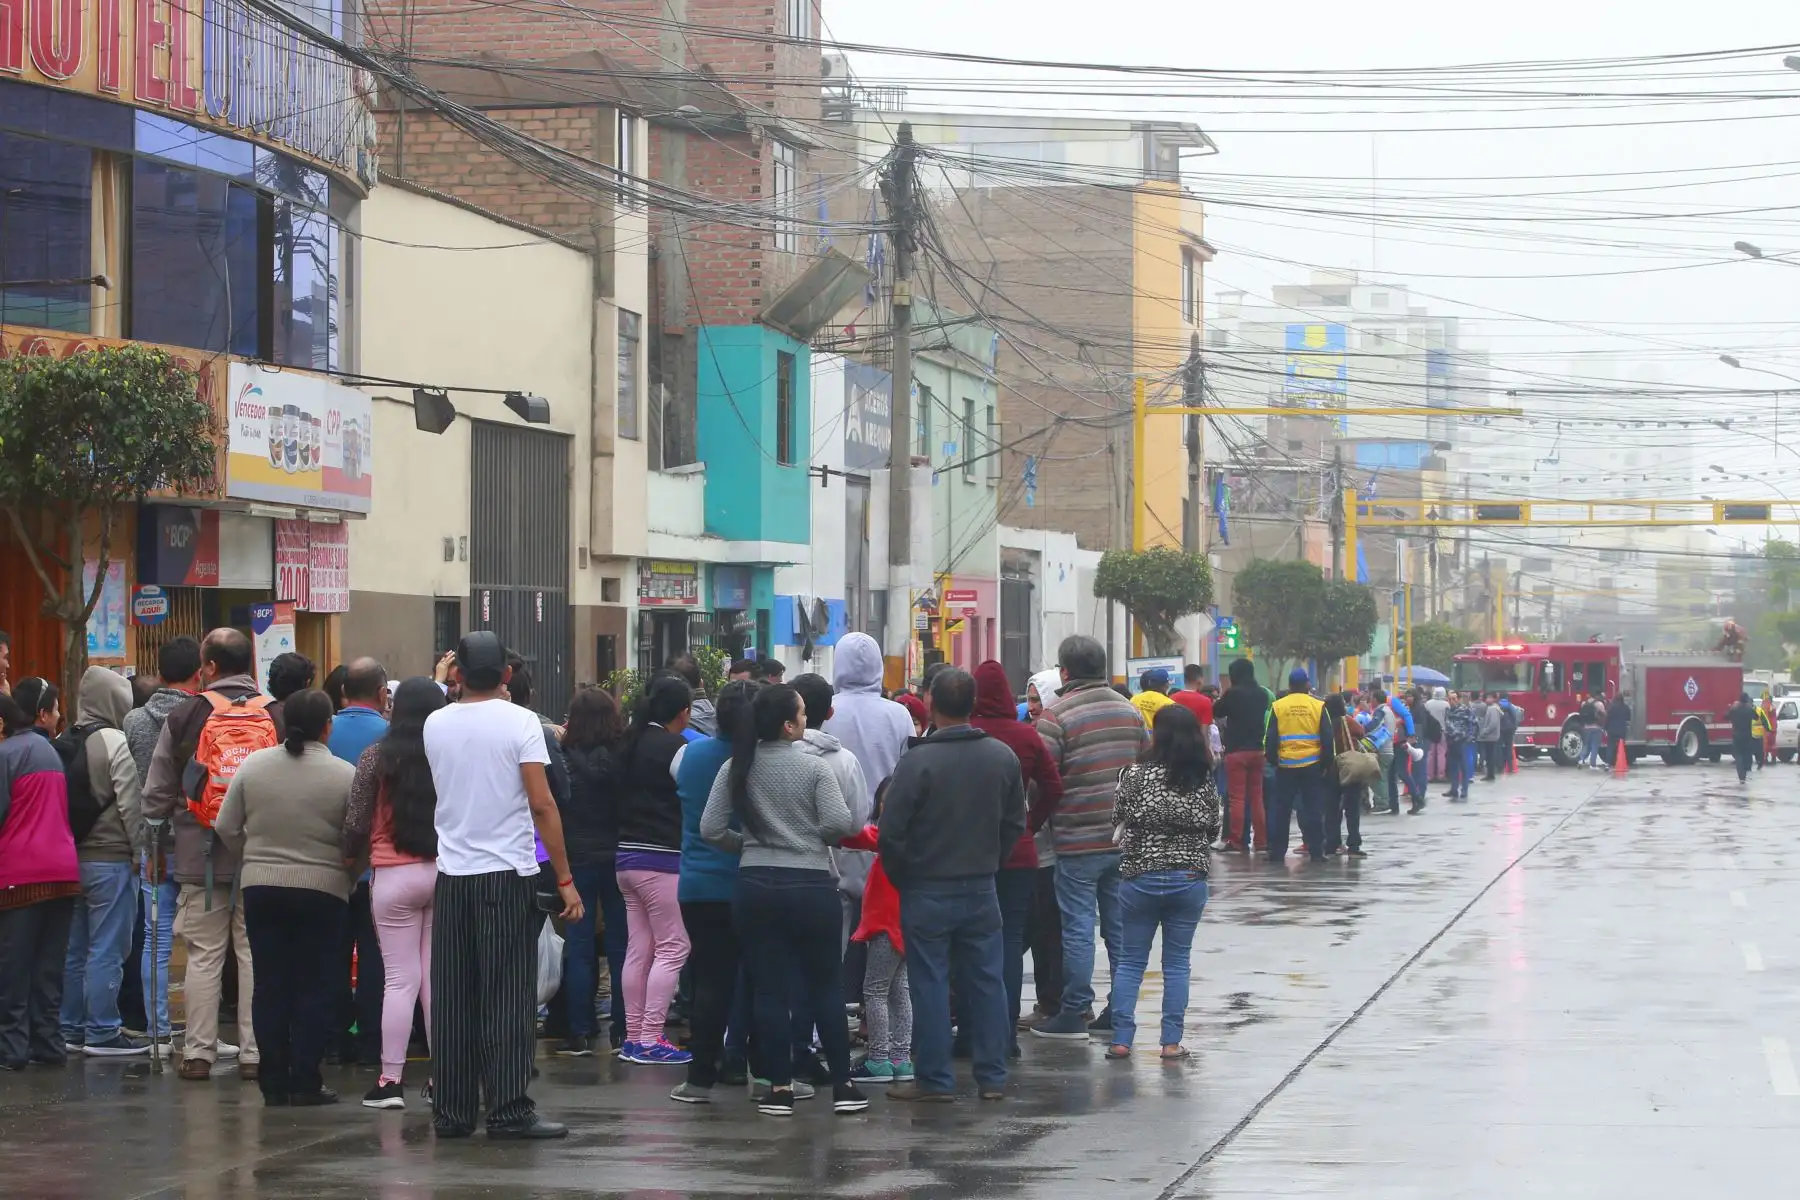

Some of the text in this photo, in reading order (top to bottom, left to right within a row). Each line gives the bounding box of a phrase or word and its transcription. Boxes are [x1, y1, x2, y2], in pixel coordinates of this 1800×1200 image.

[865, 389, 888, 418] ACEROS
[865, 421, 892, 452] AREQUIP
[170, 524, 190, 547] BCP
[195, 560, 217, 578] Agente
[257, 608, 270, 617] BCP
